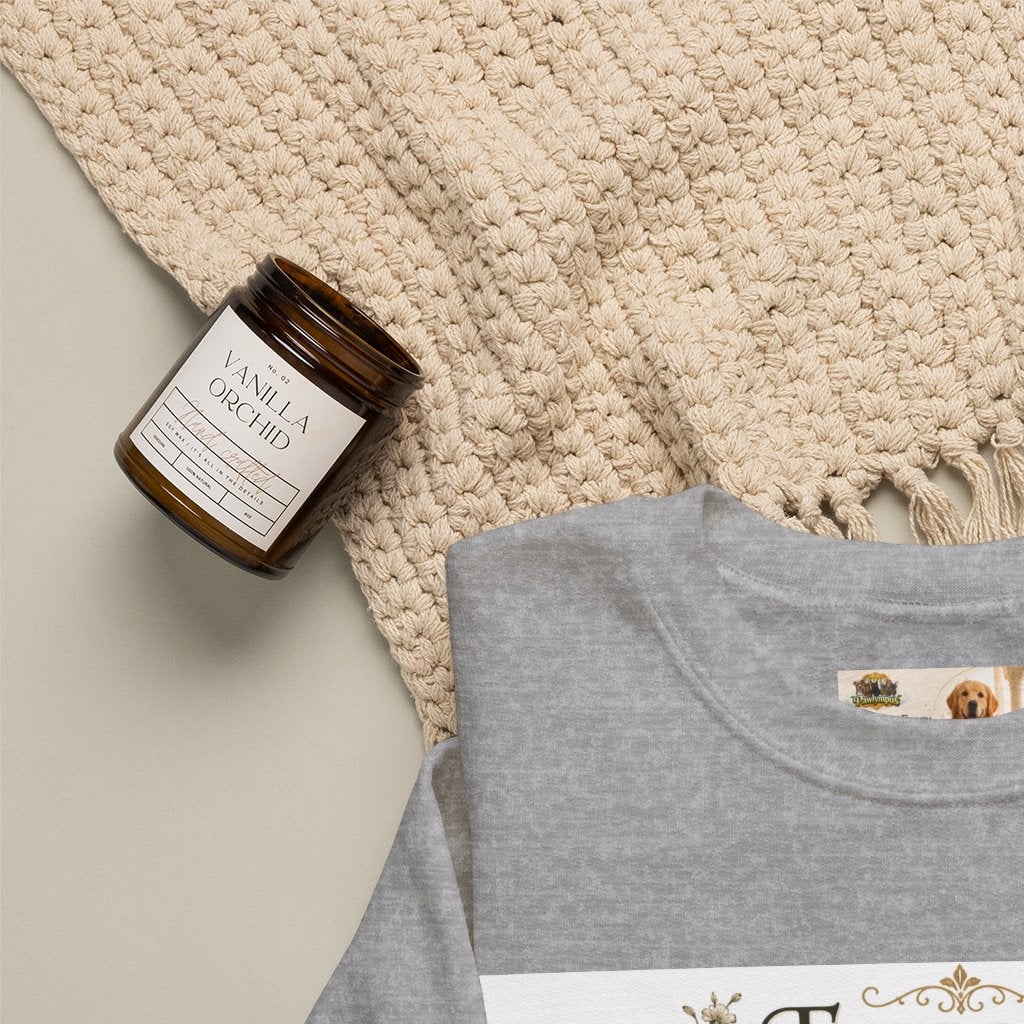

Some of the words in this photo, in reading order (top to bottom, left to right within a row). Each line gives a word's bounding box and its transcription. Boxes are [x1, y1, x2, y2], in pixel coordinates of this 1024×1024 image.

[224, 349, 309, 434] VANILLA
[267, 364, 279, 376] No.
[280, 375, 291, 385] 02
[208, 377, 291, 450] ORCHID
[203, 458, 214, 468] ALL
[225, 475, 237, 486] THE
[238, 485, 264, 505] DETAILS
